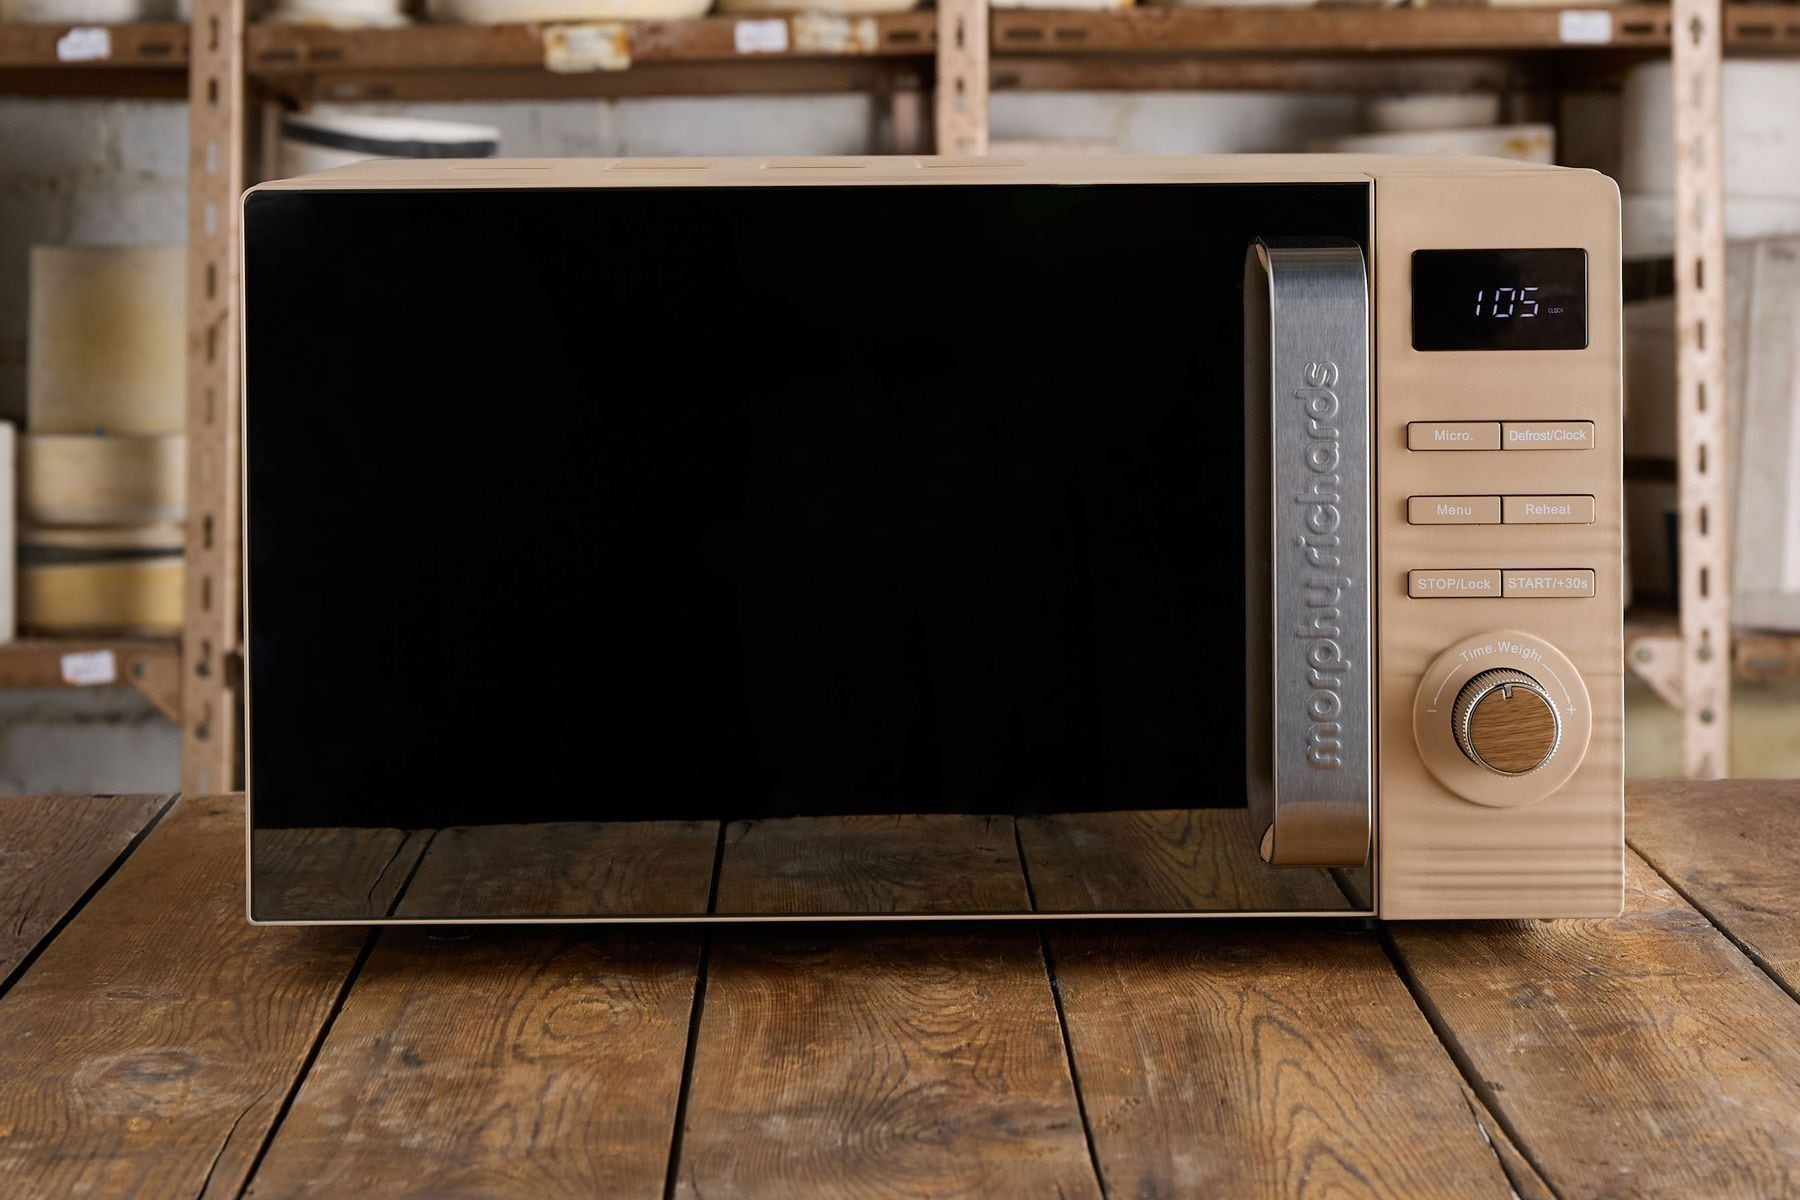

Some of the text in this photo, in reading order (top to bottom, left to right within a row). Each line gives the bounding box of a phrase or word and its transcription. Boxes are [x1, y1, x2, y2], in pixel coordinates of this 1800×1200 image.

[1475, 287, 1539, 318] 105
[1434, 430, 1474, 441] Micro.
[1509, 429, 1586, 442] Defrost/Clock
[1436, 504, 1472, 516] Menu
[1525, 503, 1571, 515] Reheat
[1294, 358, 1352, 771] morphy richards
[1417, 578, 1491, 590] STOP/Lock
[1507, 577, 1588, 590] START/+30s
